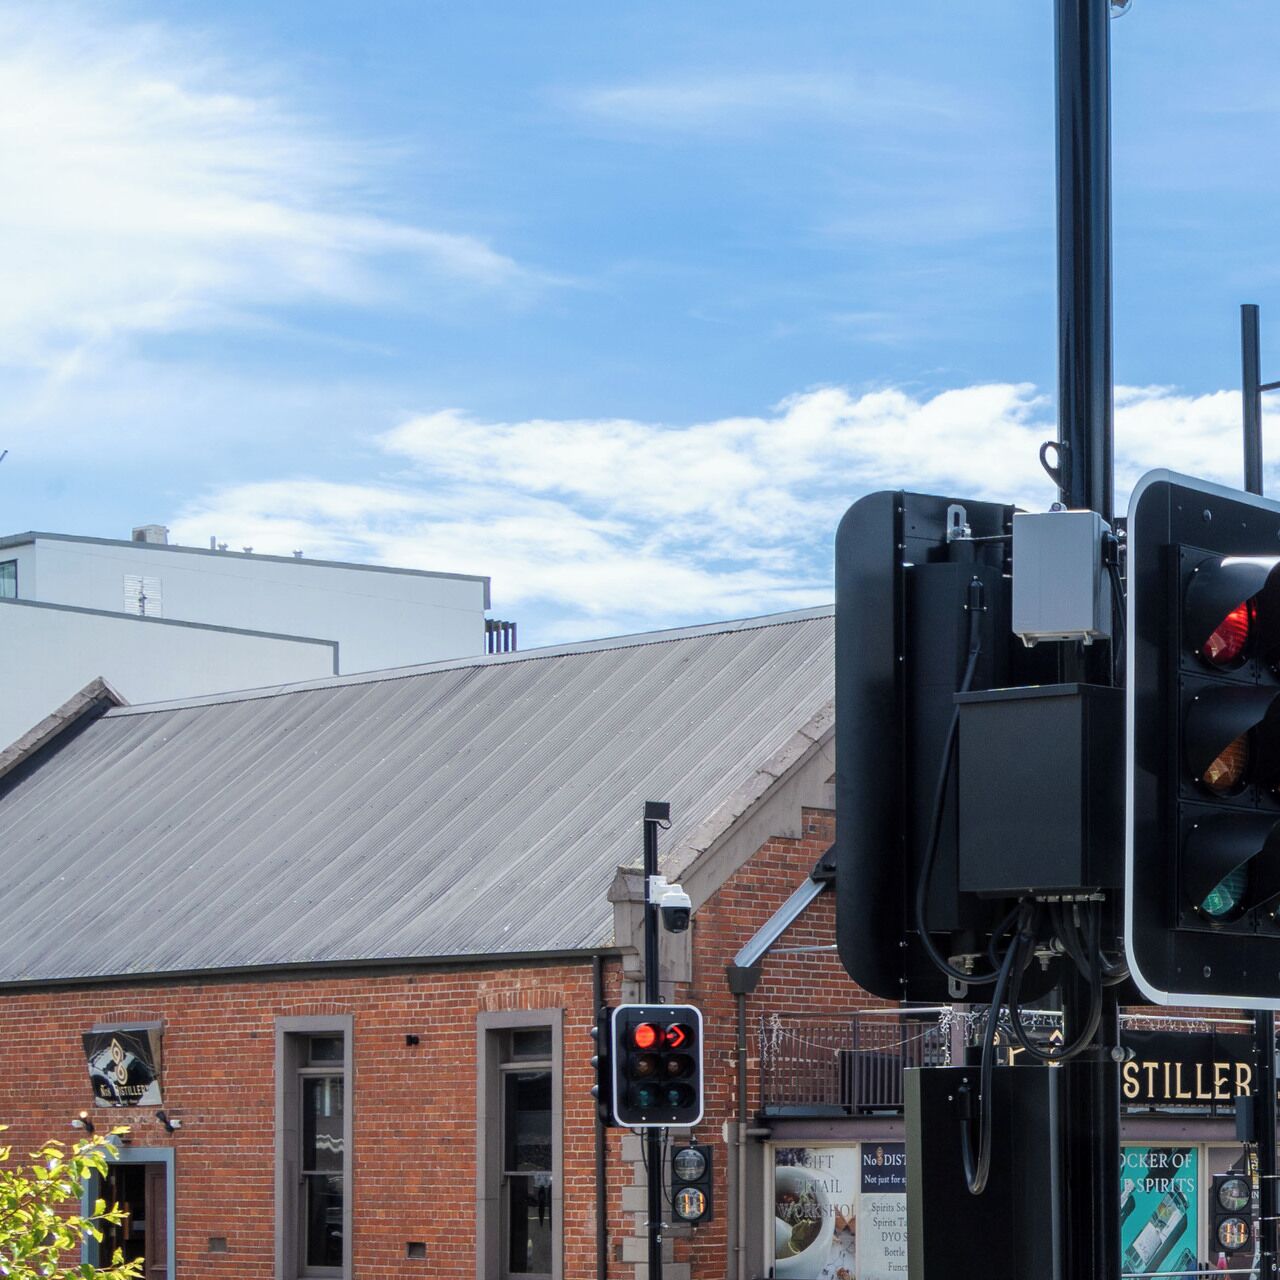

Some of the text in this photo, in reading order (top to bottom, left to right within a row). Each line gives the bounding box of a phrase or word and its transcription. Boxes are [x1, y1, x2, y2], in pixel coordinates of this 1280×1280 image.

[1122, 1061, 1252, 1100] STILLER
[884, 1154, 907, 1166] DIST
[1120, 1153, 1192, 1168] OCKER OF
[864, 1174, 877, 1183] Not
[878, 1174, 890, 1185] just
[890, 1174, 901, 1183] for
[1136, 1178, 1194, 1193] SPIRITS
[871, 1202, 908, 1214] Spirits So
[873, 1217, 896, 1229] Spirits
[656, 1234, 662, 1243] 5
[884, 1247, 905, 1257] Bottle
[1271, 1264, 1277, 1272] 6
